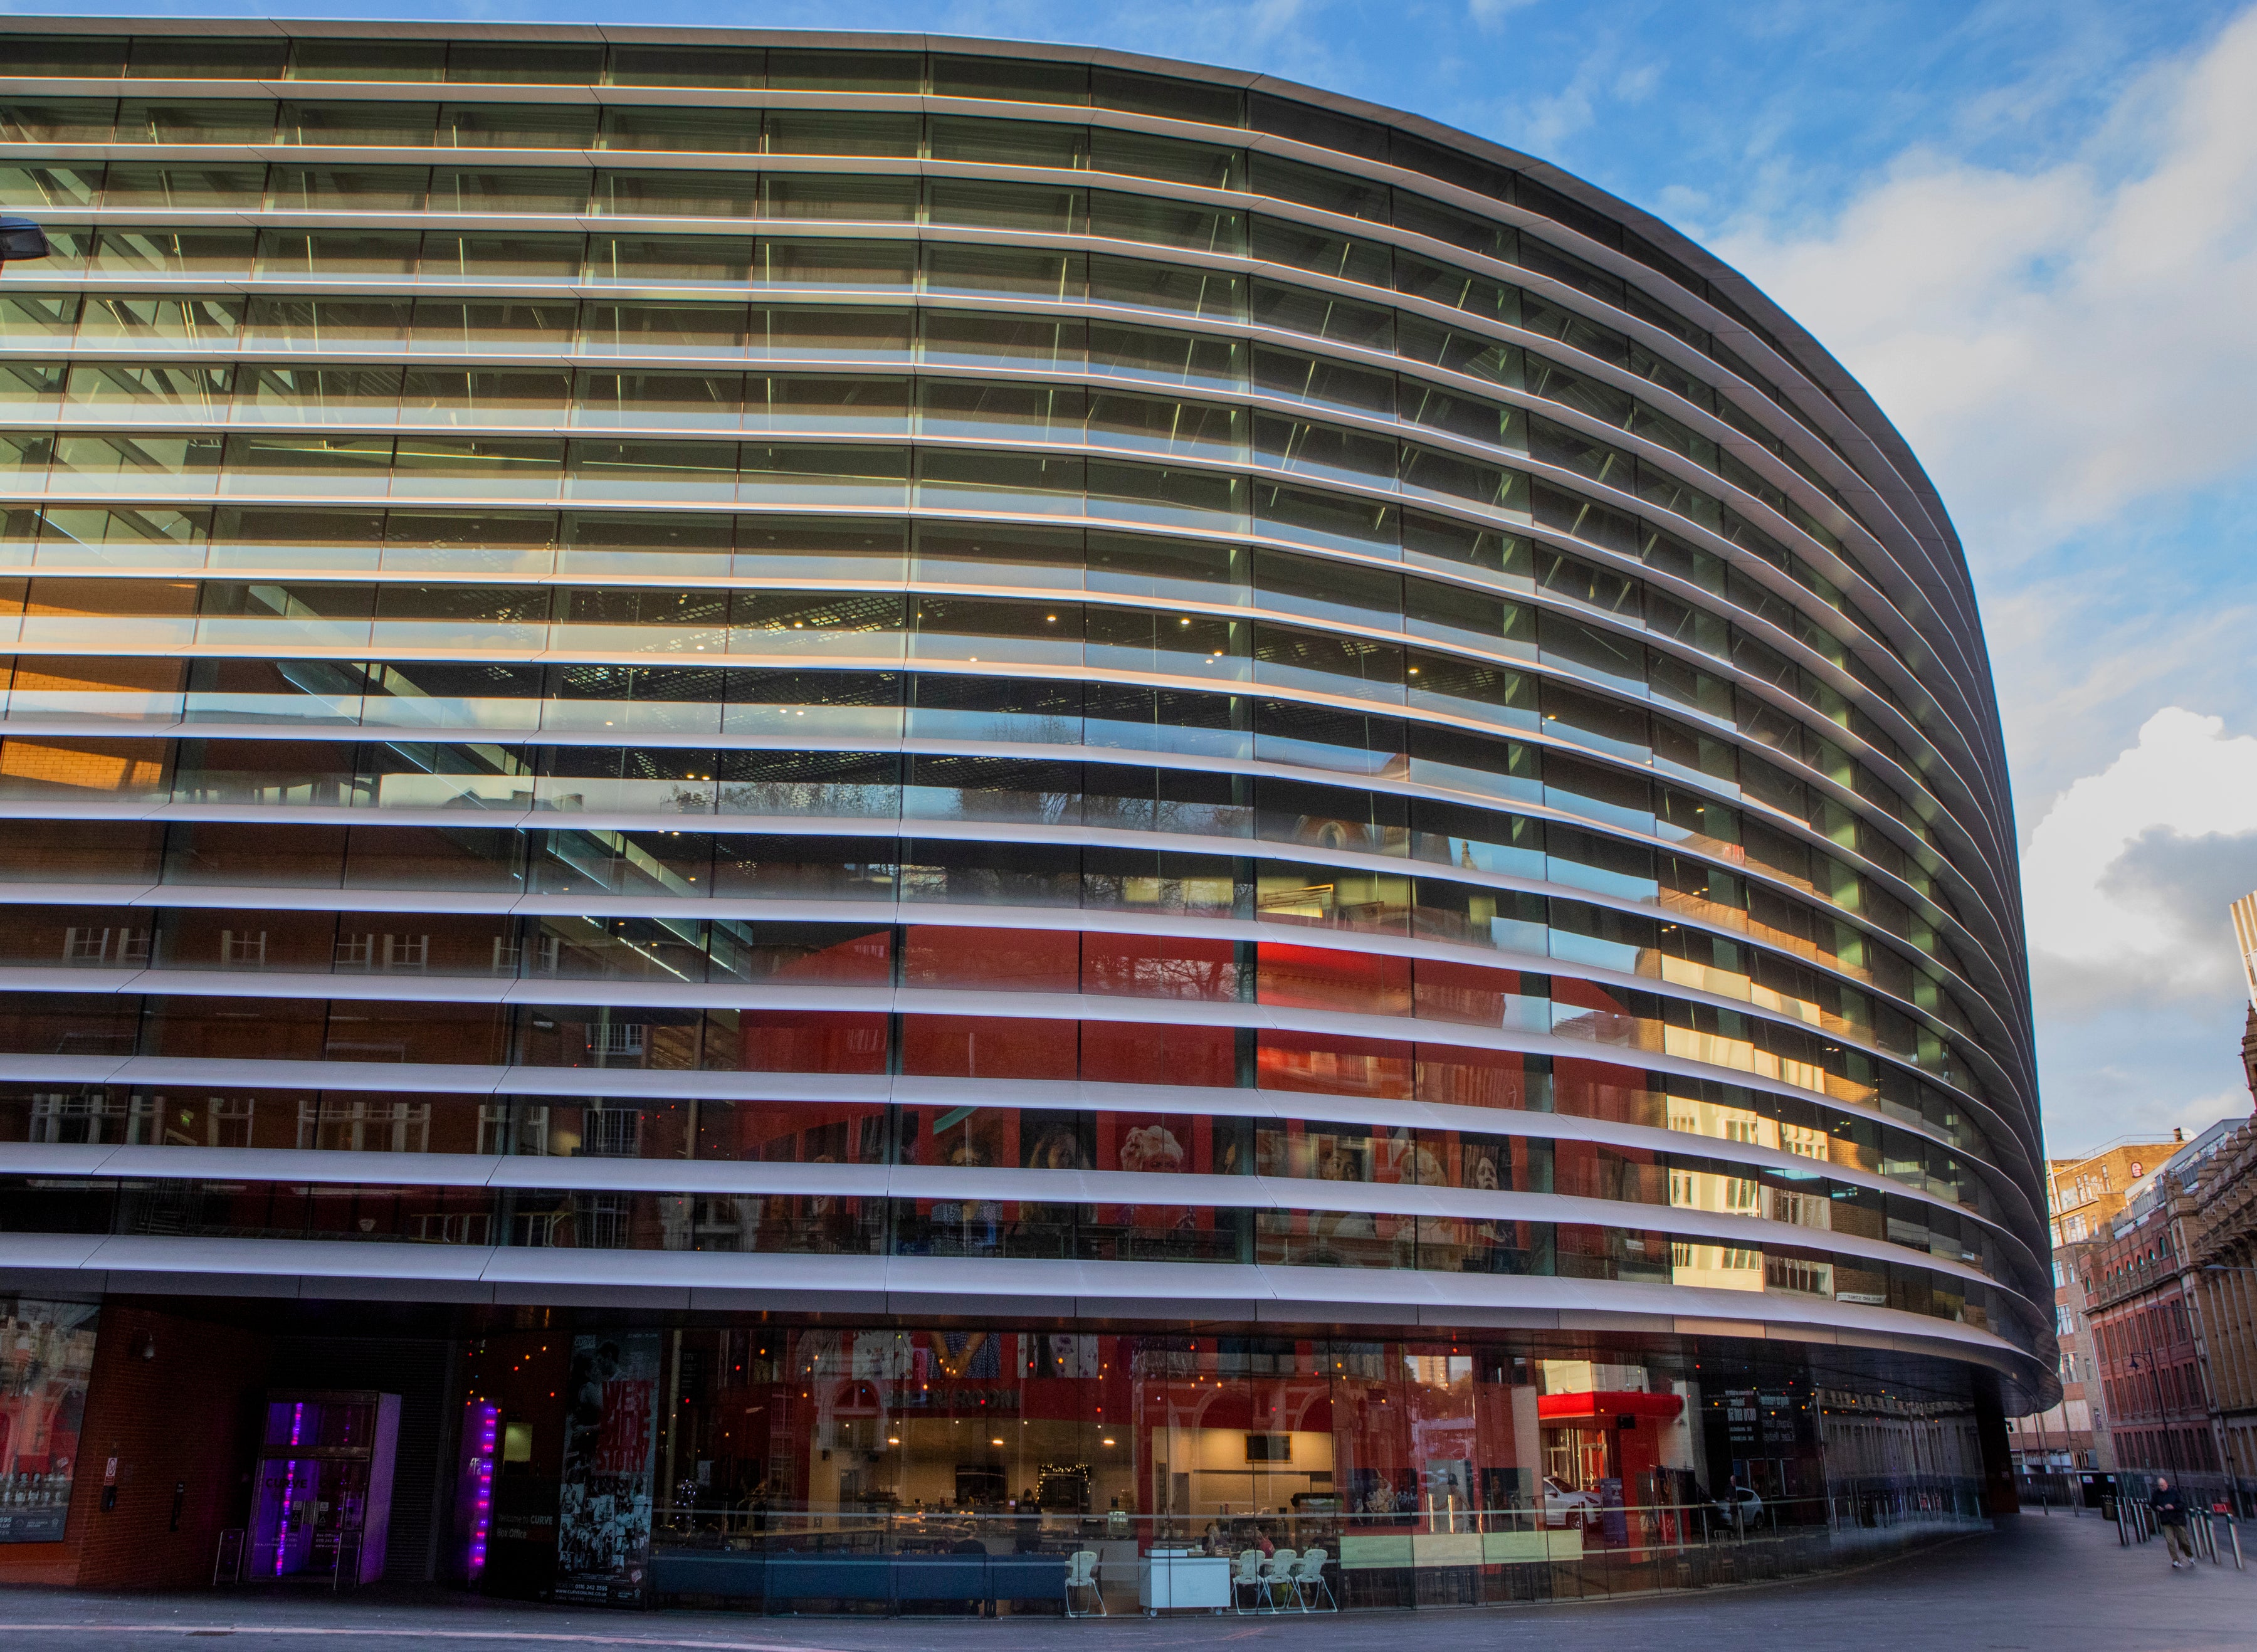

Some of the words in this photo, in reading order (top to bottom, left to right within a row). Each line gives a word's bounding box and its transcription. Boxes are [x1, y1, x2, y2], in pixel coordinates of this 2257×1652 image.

[602, 1380, 655, 1409] WEST
[599, 1409, 651, 1446] SIDE
[596, 1444, 649, 1472] STORY
[266, 1478, 307, 1488] CURVE
[498, 1514, 522, 1523] Welcome
[530, 1515, 554, 1525] CURVE
[497, 1527, 508, 1538] Box
[509, 1528, 527, 1539] Office
[555, 1589, 608, 1597] WWW.CURVEONLINE.CO.UK
